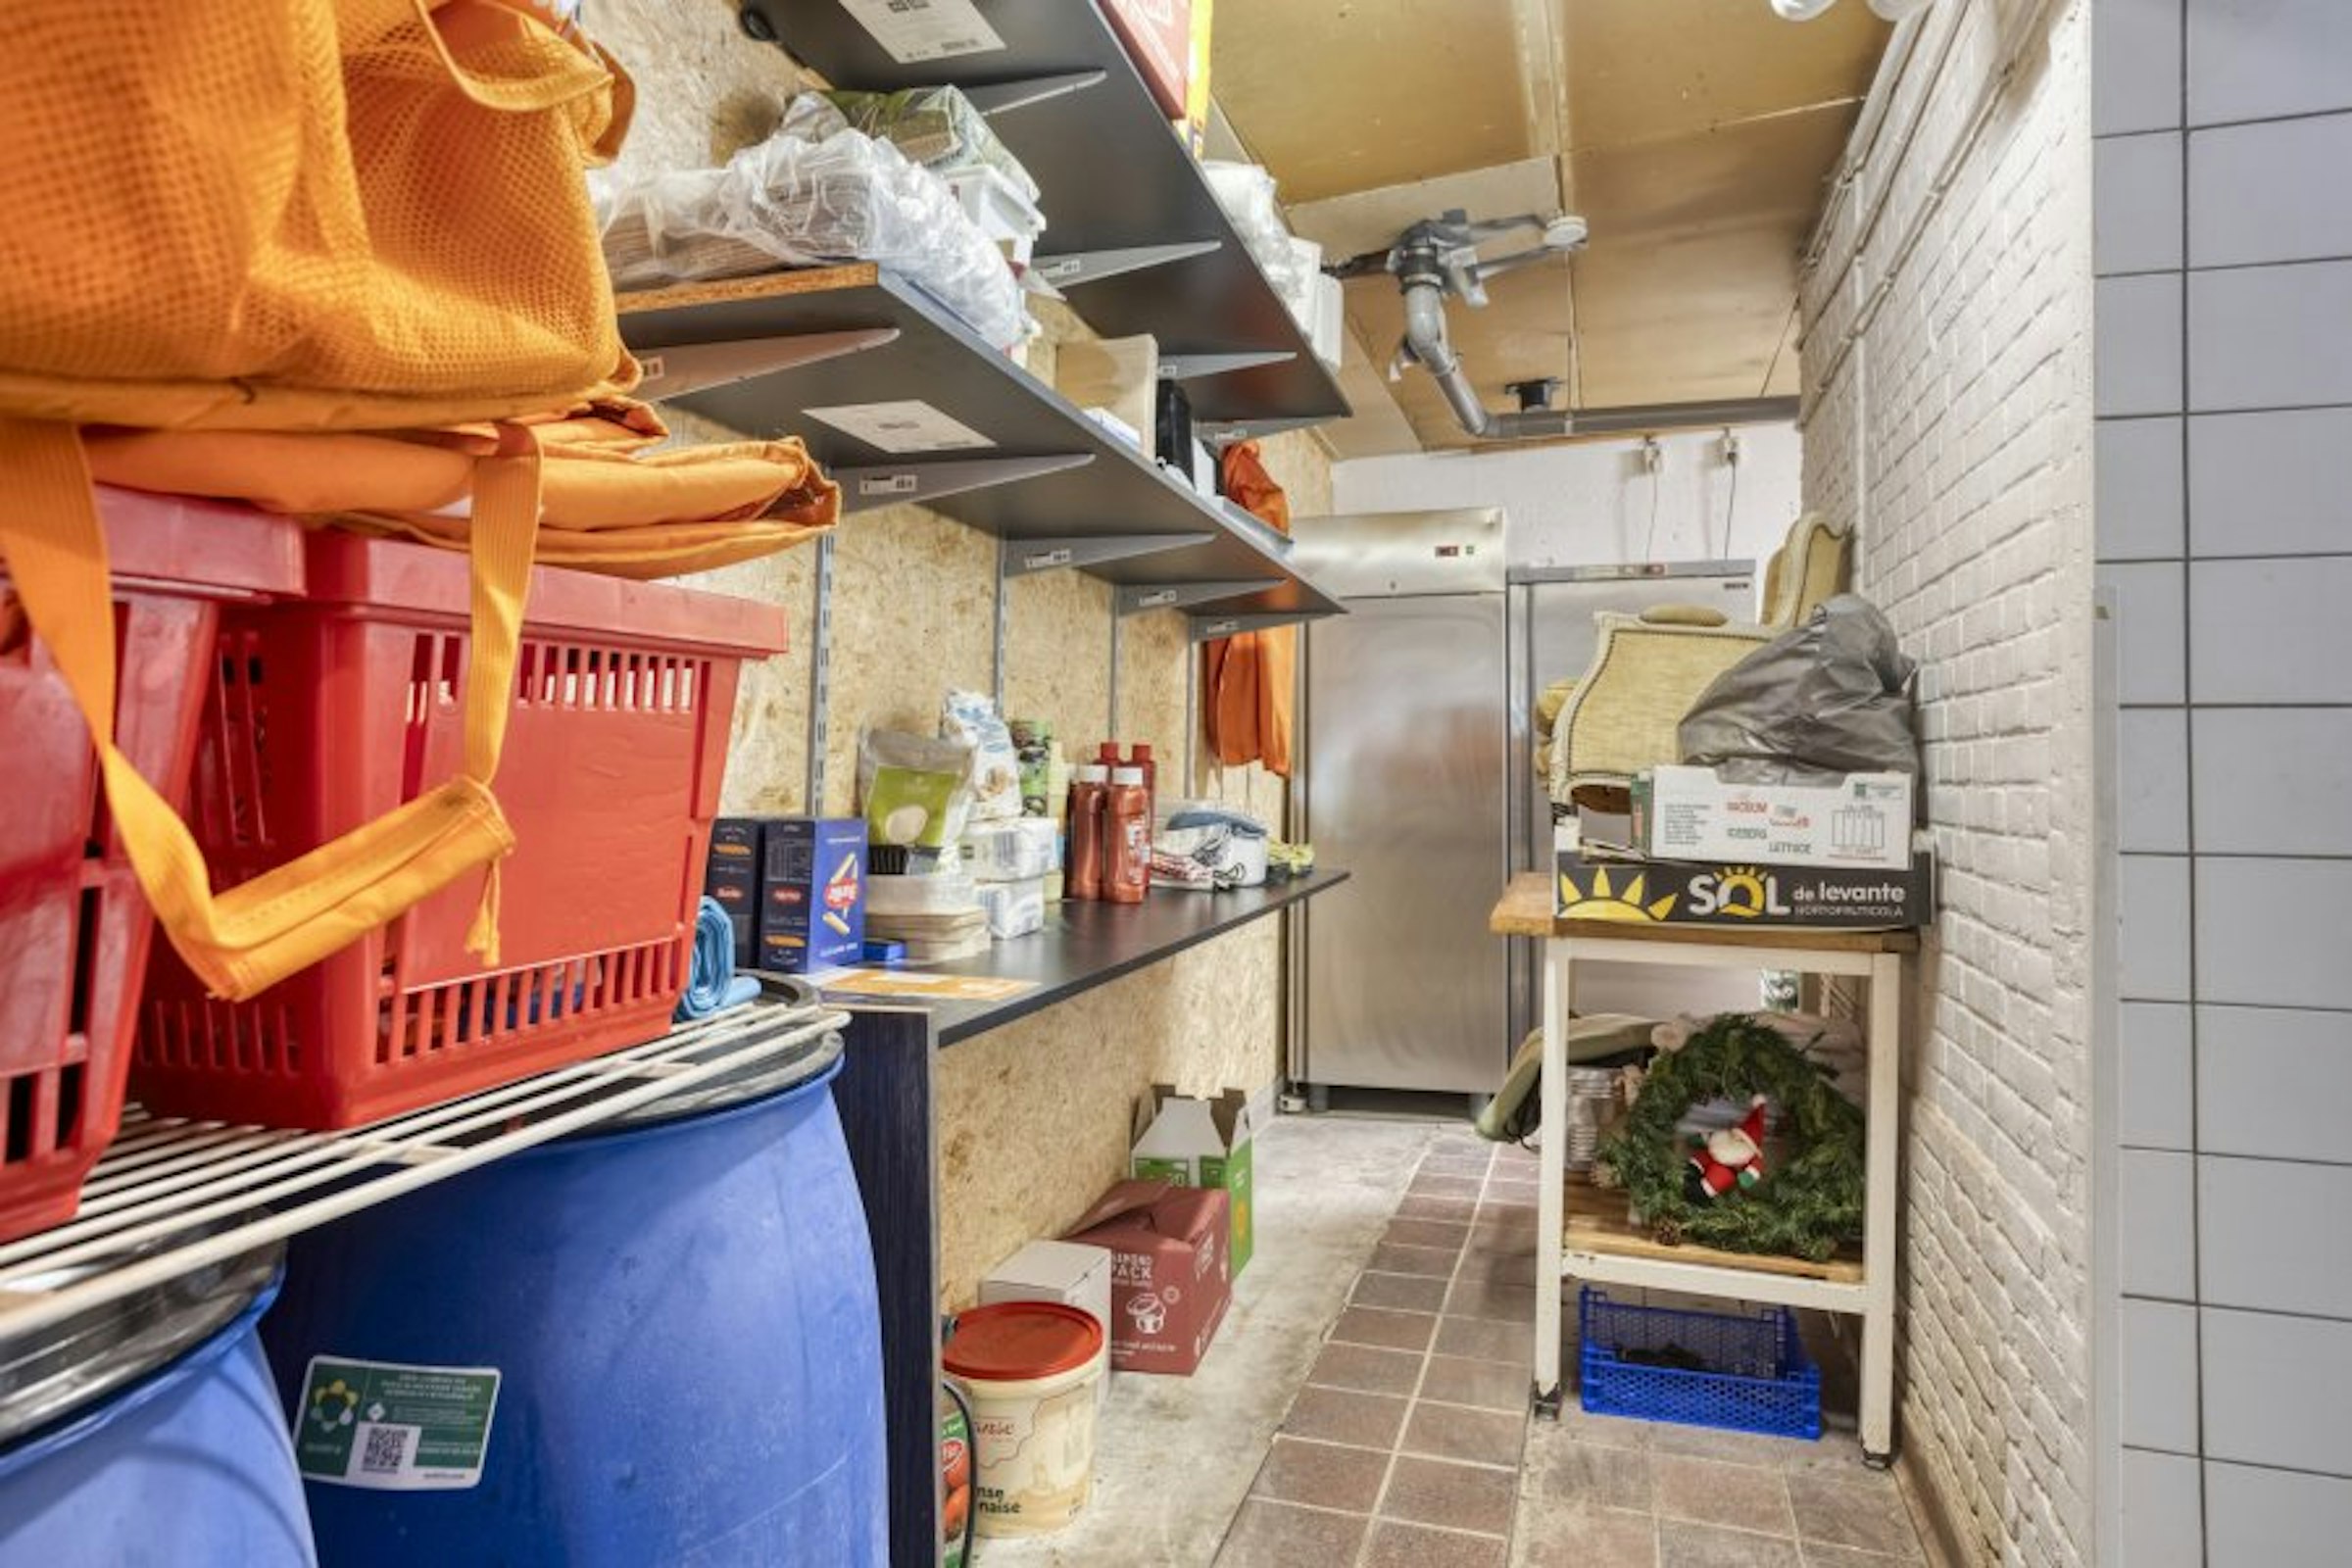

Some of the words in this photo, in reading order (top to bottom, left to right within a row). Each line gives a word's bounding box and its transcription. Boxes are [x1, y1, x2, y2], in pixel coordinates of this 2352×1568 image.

[1688, 871, 1791, 918] SOL
[1792, 885, 1814, 902] de
[1819, 881, 1906, 903] levante
